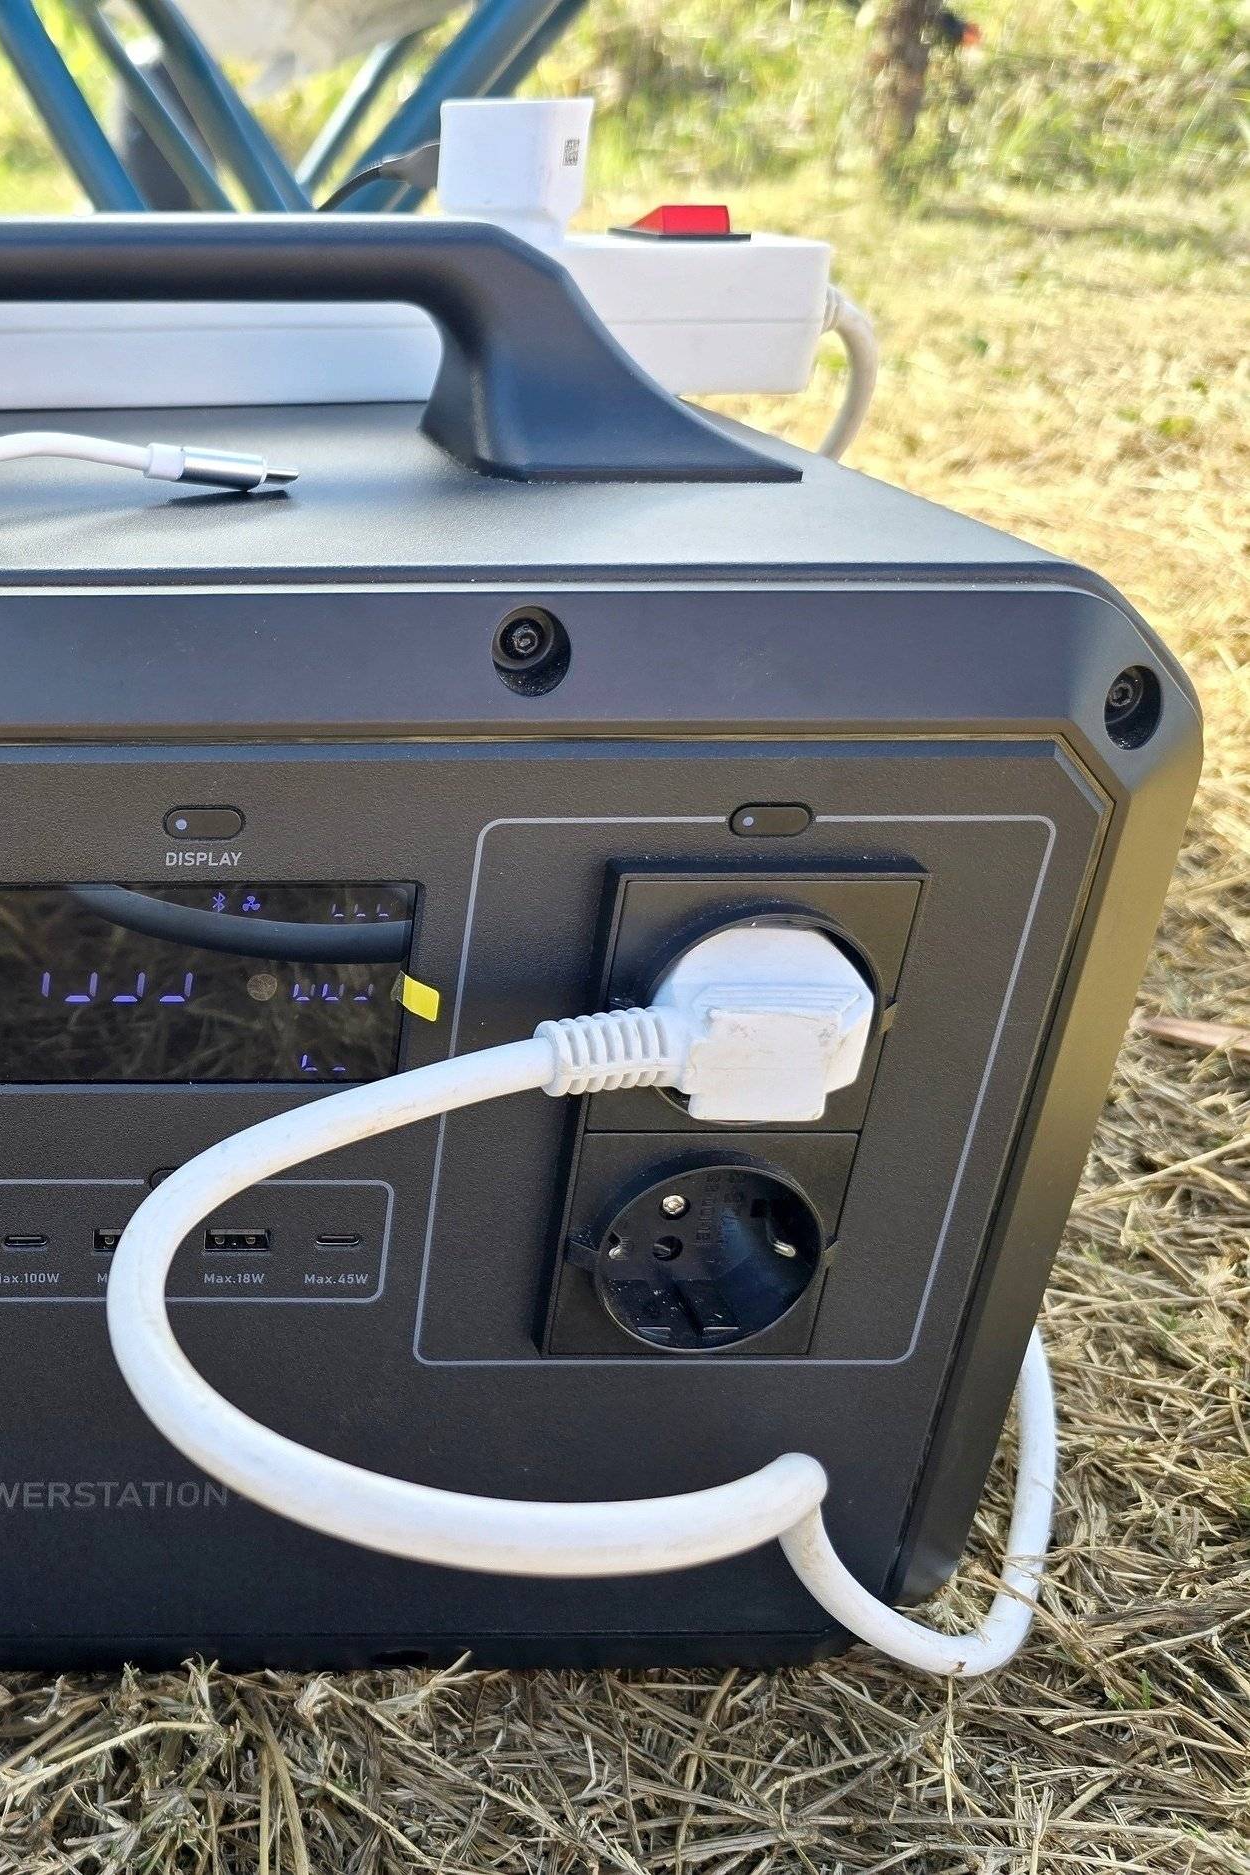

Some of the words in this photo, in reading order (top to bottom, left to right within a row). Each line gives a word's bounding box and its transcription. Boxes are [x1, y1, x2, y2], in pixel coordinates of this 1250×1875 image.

[165, 851, 242, 867] DISPLAY
[203, 1273, 266, 1286] Max.18W
[304, 1273, 370, 1286] Max.45W
